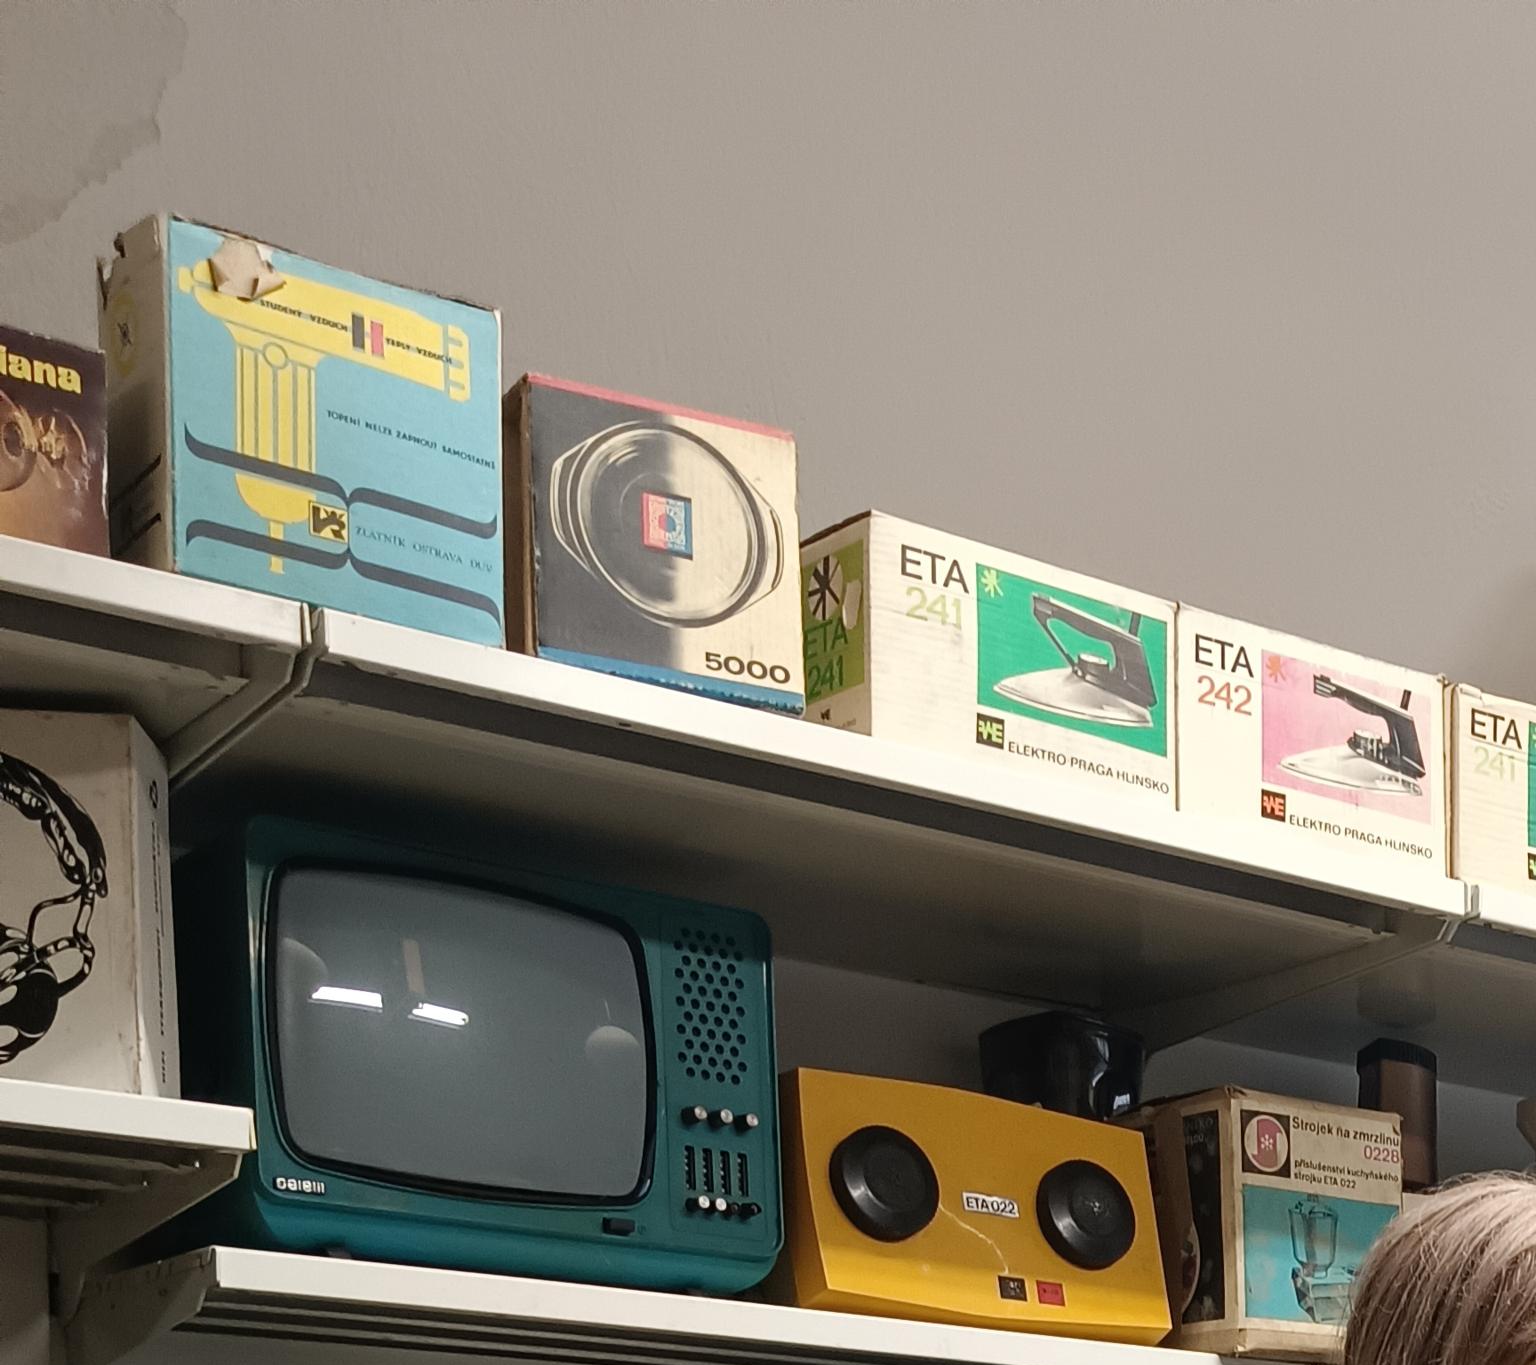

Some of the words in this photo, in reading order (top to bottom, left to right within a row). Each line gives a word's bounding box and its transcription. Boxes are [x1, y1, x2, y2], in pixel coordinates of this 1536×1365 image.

[412, 543, 463, 565] OSTRAVA
[901, 543, 970, 594] ETA
[906, 586, 963, 631] 241
[803, 617, 848, 659] ETA
[1195, 633, 1255, 679] ETA
[705, 651, 791, 685] 5000
[807, 655, 844, 699] 241
[1197, 674, 1253, 717] 242
[1470, 707, 1523, 750] ETA
[1008, 741, 1067, 767] ELEKTRO
[1070, 757, 1114, 778] PRAGA
[1116, 769, 1170, 795] HLINSKO
[1473, 745, 1516, 784] 241
[1289, 814, 1341, 836] ELEKTRO
[1344, 827, 1383, 847] PRAGA
[1385, 838, 1433, 859] HLINSKO
[1291, 1116, 1334, 1138] Strojek
[1335, 1125, 1351, 1139] na
[1352, 1129, 1400, 1148] zmrzlinu
[1362, 1144, 1400, 1164] 0228
[1323, 1176, 1339, 1187] ETA
[1340, 1178, 1357, 1190] 022
[965, 1196, 990, 1211] ETA
[990, 1200, 1016, 1216] 022
